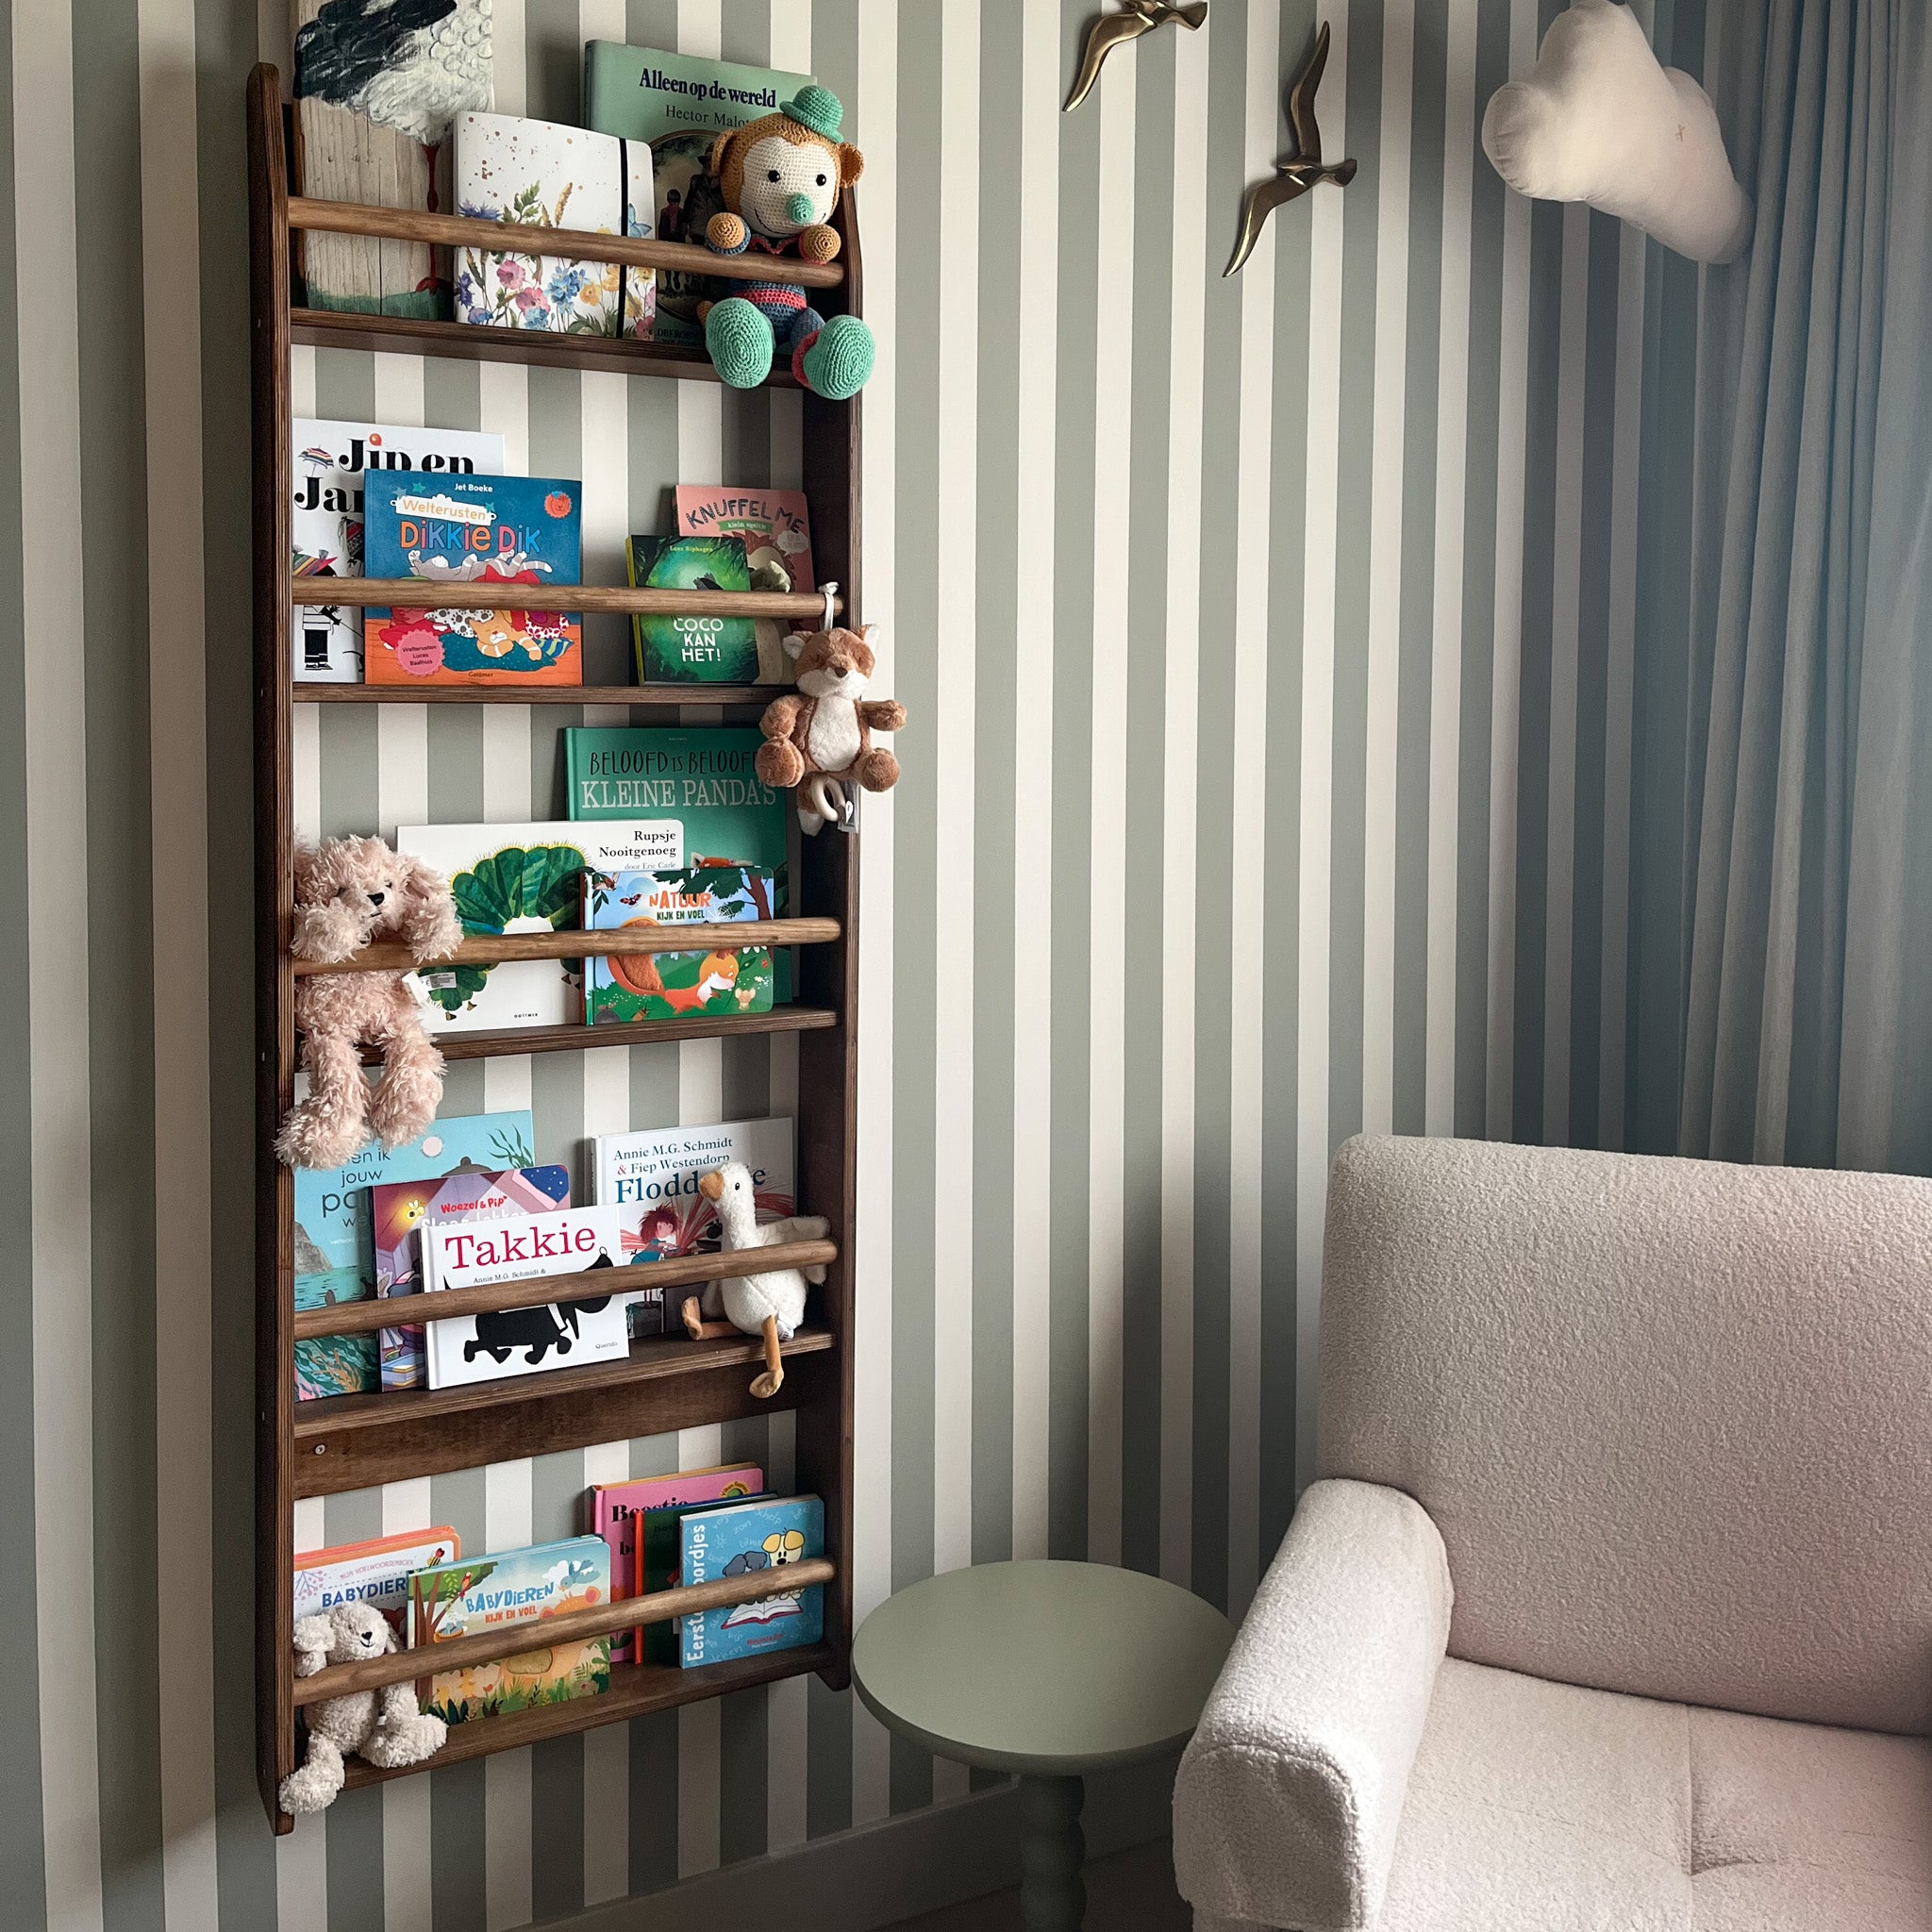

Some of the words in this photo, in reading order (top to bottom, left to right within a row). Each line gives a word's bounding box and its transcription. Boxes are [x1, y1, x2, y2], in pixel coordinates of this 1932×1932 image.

[639, 67, 688, 94] Alleen
[690, 82, 708, 101] op
[708, 80, 726, 100] de
[727, 87, 776, 108] wereld
[665, 104, 709, 123] Hector
[455, 483, 467, 491] Jet
[468, 483, 493, 492] Boeke
[402, 498, 487, 521] Welterusten
[685, 498, 772, 530] KNUFFEL
[774, 506, 805, 534] ME
[673, 617, 724, 632] COCO
[683, 632, 716, 647] KAN
[681, 648, 722, 662] HET!
[590, 749, 669, 776] BELOOFD
[688, 749, 758, 775] BELOOF
[581, 779, 676, 809] KLEINE
[681, 778, 777, 808] PANDA'S
[633, 829, 677, 843] Rupsje
[598, 845, 678, 859] Nooitgenoeg
[624, 862, 641, 871] door
[642, 861, 656, 870] Eric
[648, 890, 712, 909] NATUUR
[657, 911, 674, 922] KIJK
[675, 910, 686, 920] EN
[687, 909, 706, 920] VOEL
[613, 1147, 650, 1161] Annie
[652, 1142, 680, 1157] M.G.
[683, 1137, 733, 1154] Schmidt
[617, 1164, 627, 1176] &
[630, 1161, 658, 1175] Fiep
[341, 1169, 383, 1189] jouw
[441, 1195, 479, 1214] Woezel
[479, 1201, 487, 1209] &
[488, 1195, 506, 1208] Pip
[444, 1222, 596, 1271] Takkie
[473, 1274, 494, 1284] Annie
[511, 1269, 540, 1280] Schmidt
[322, 1576, 408, 1608] BABYDIER
[485, 1611, 504, 1624] KIJK
[506, 1608, 516, 1621] EN
[518, 1605, 538, 1617] VOEL
